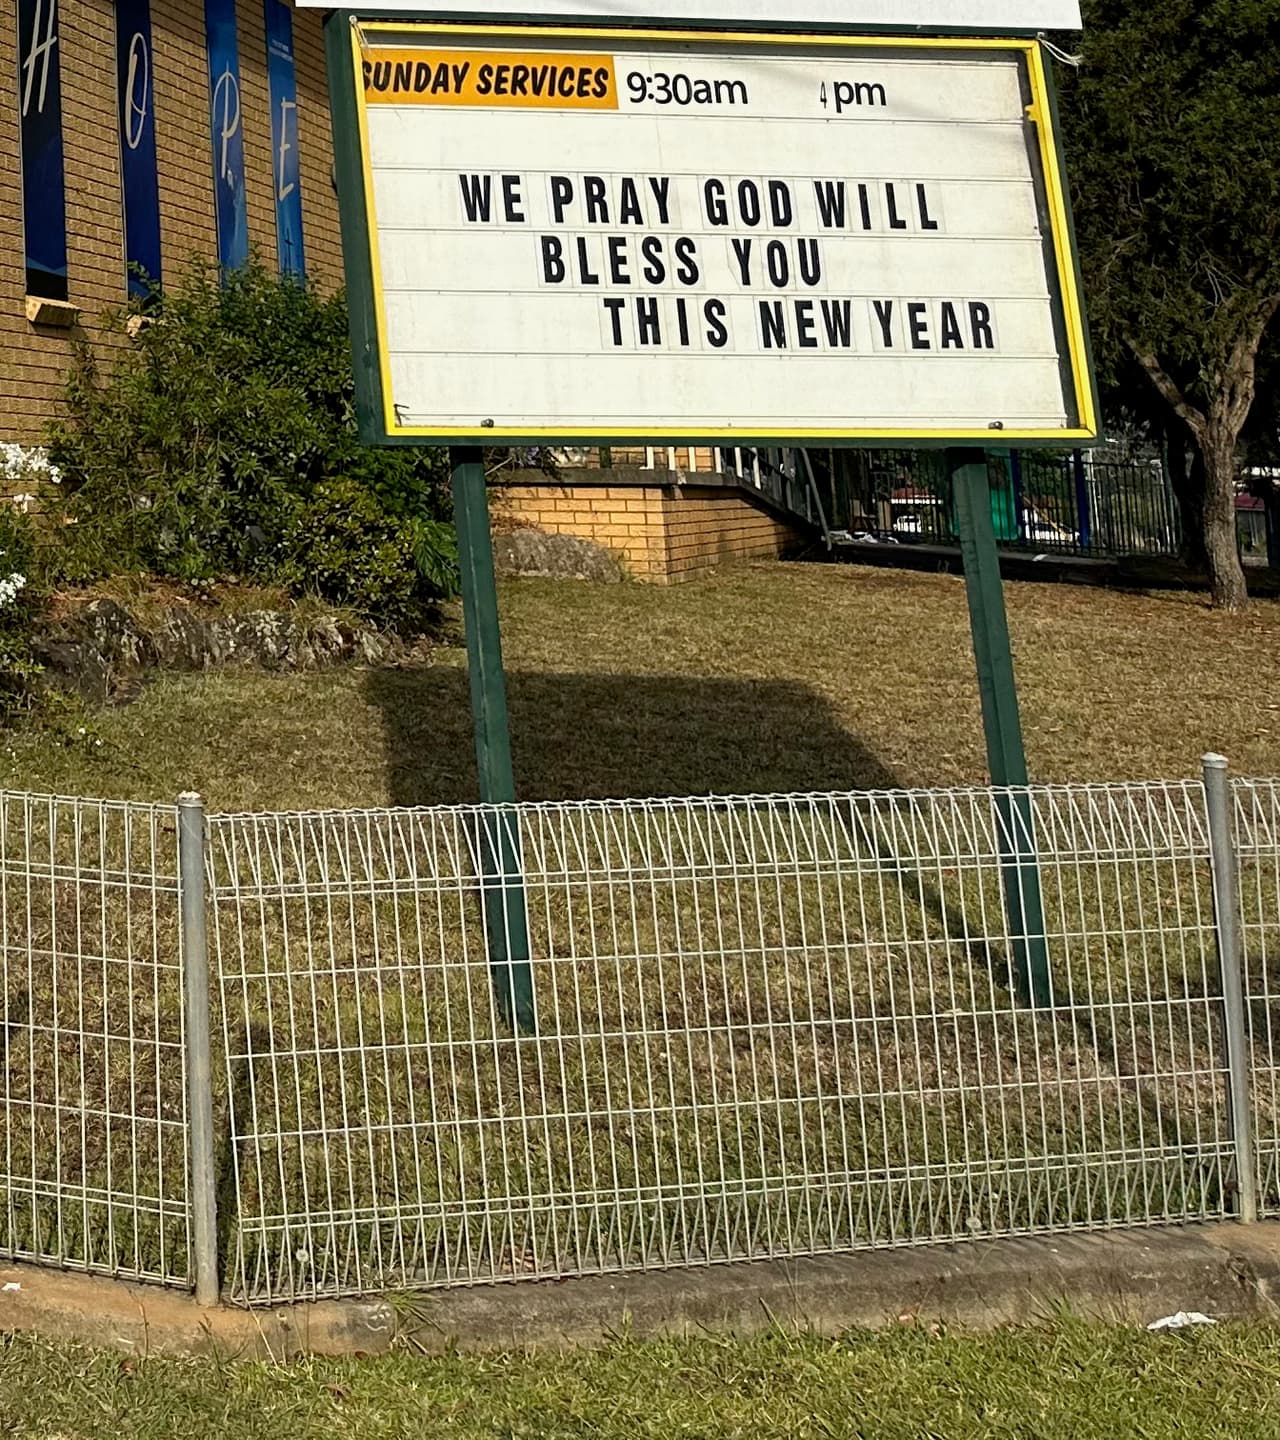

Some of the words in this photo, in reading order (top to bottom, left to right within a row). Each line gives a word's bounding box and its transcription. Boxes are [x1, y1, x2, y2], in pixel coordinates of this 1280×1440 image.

[362, 60, 470, 94] SUNDAY
[475, 63, 609, 99] SERVICES
[626, 71, 748, 105] 9:30am
[833, 80, 887, 114] pm
[460, 174, 525, 223] WE
[551, 175, 670, 226] PRAY
[704, 178, 793, 227] GOD
[814, 180, 938, 231] WILL
[541, 235, 699, 286] BLESS
[732, 238, 821, 288] YOU
[604, 296, 728, 348] THIS
[759, 299, 851, 349] NEW
[874, 300, 994, 350] YEAR
